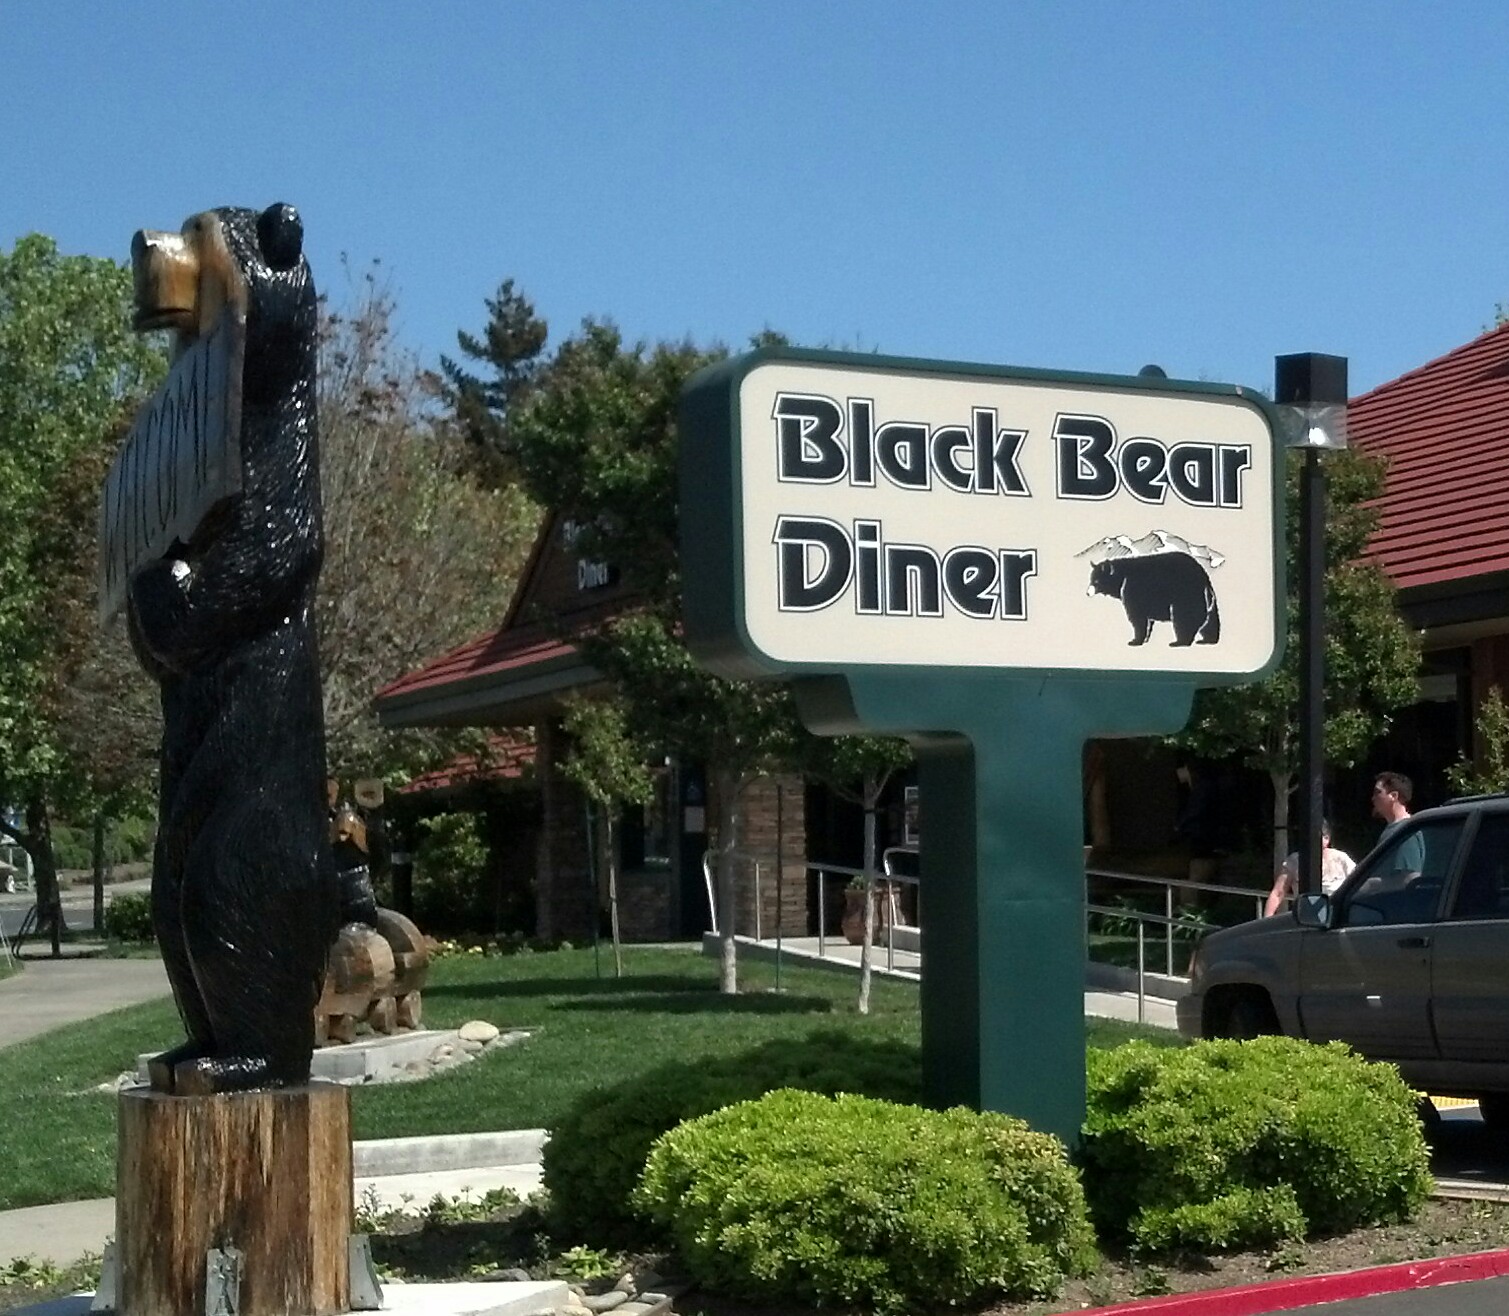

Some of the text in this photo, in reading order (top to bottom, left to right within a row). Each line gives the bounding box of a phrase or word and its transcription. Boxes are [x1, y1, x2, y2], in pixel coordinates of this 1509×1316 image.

[770, 391, 1252, 509] Black Bear
[771, 514, 1038, 621] Diner
